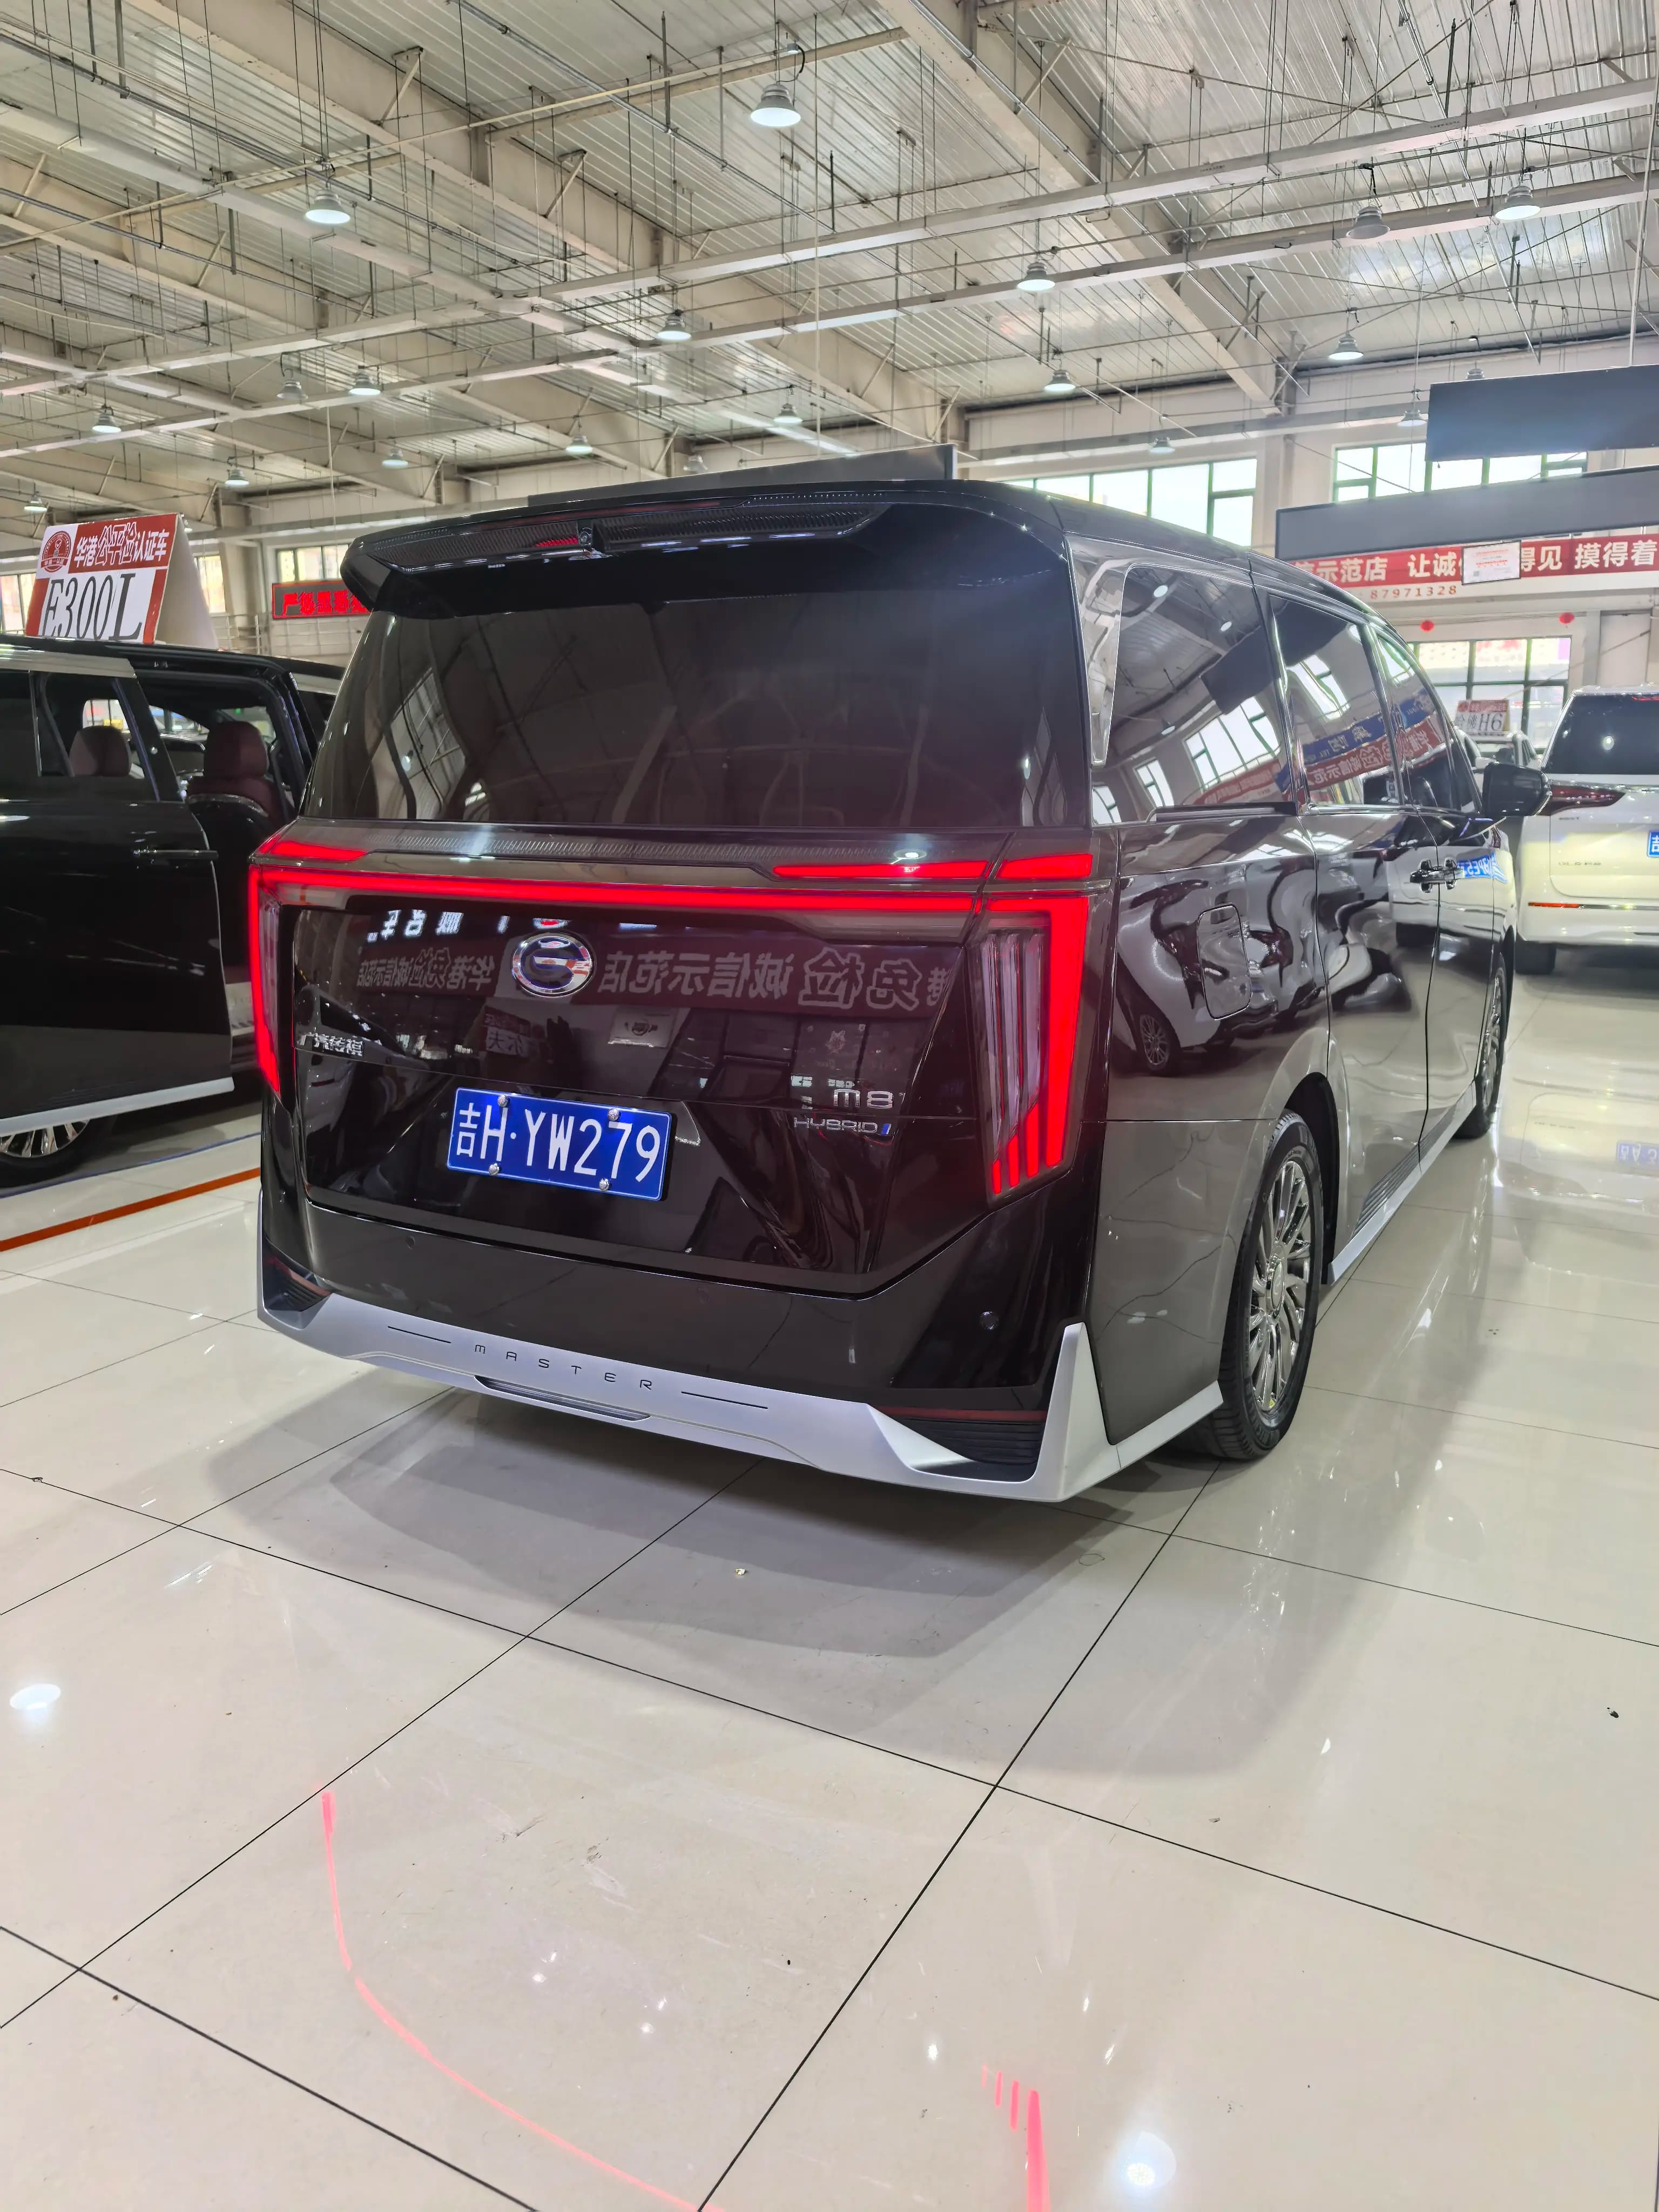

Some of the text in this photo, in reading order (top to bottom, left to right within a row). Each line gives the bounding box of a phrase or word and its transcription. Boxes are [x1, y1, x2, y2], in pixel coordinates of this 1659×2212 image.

[1574, 539, 1657, 569] 摸得着
[42, 573, 142, 640] E300L
[1370, 585, 1456, 599] 87971328
[794, 1117, 878, 1133] HYBRID
[475, 1344, 652, 1390] MASTER
